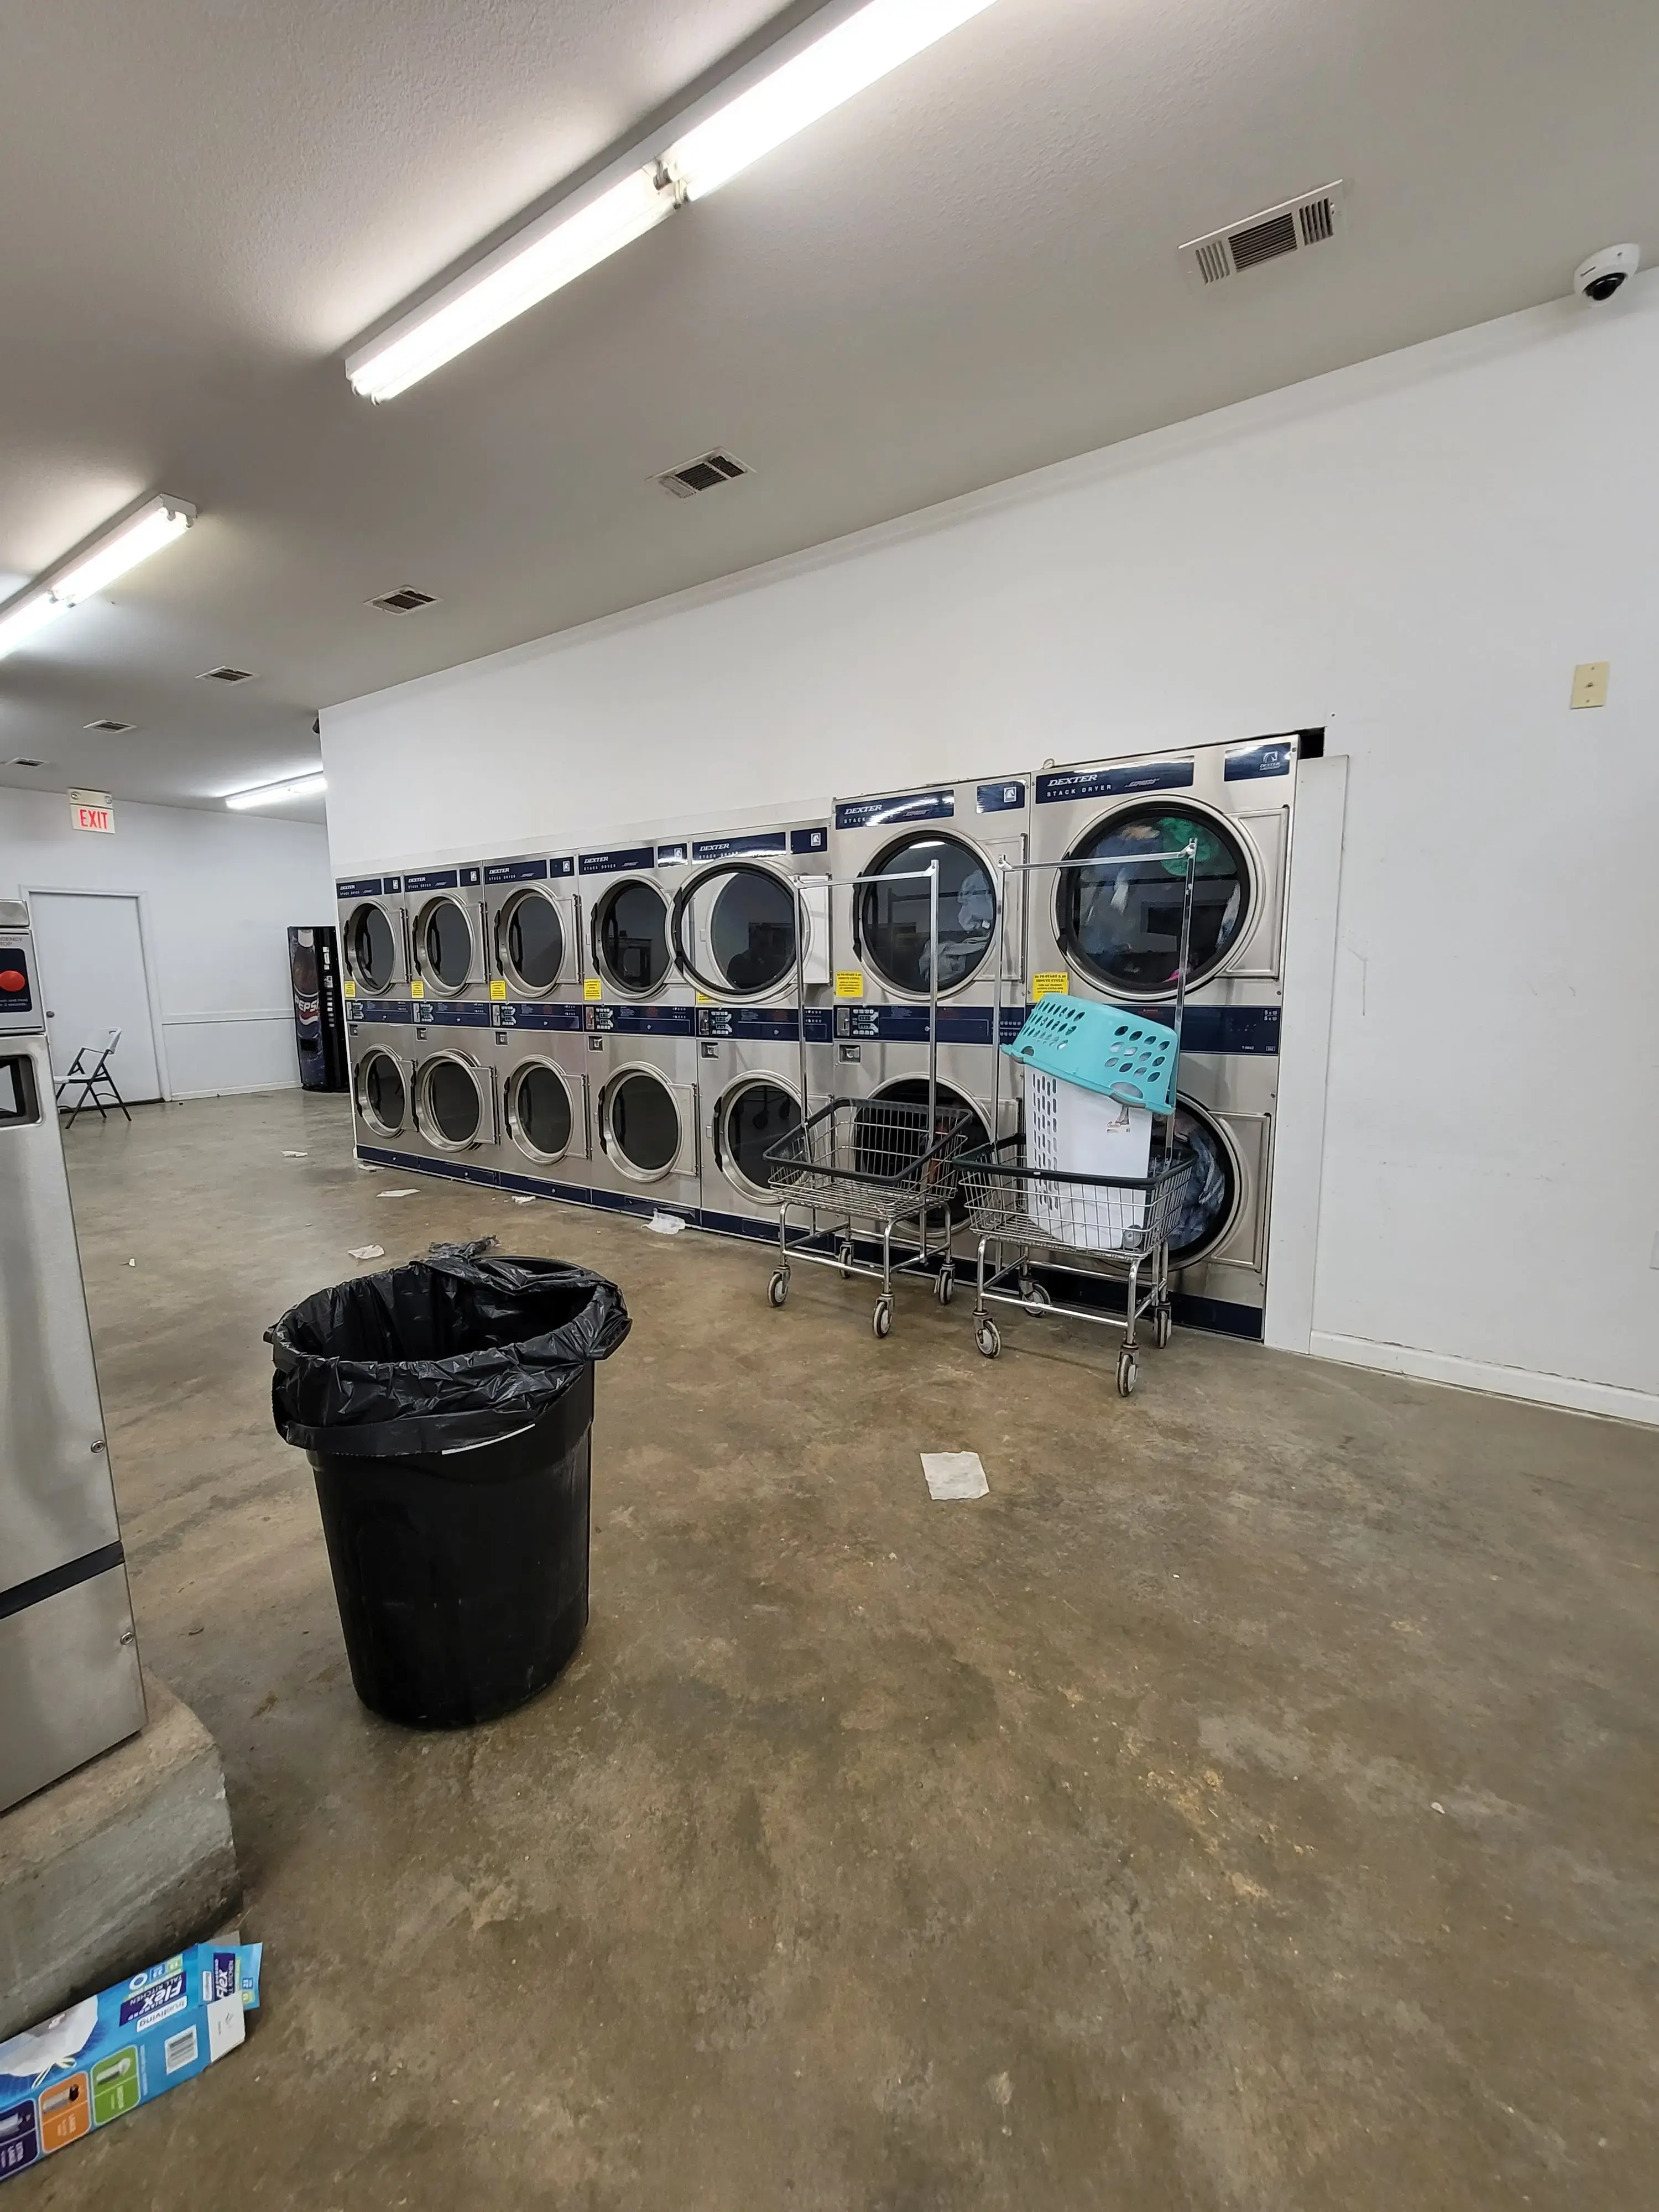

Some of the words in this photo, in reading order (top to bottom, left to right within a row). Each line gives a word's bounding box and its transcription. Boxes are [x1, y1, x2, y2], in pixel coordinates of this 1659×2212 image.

[1047, 774, 1098, 787] DEXTER
[1046, 789, 1076, 797] STACK
[844, 805, 883, 815] DEXTER
[80, 809, 108, 830] EXIT
[699, 843, 730, 852] DEXTER
[295, 993, 319, 1012] PEPSI
[165, 1974, 182, 1986] TALL
[216, 1969, 228, 1997] Flex
[129, 1984, 163, 2006] KITCHEN
[143, 1979, 182, 2008] Flex
